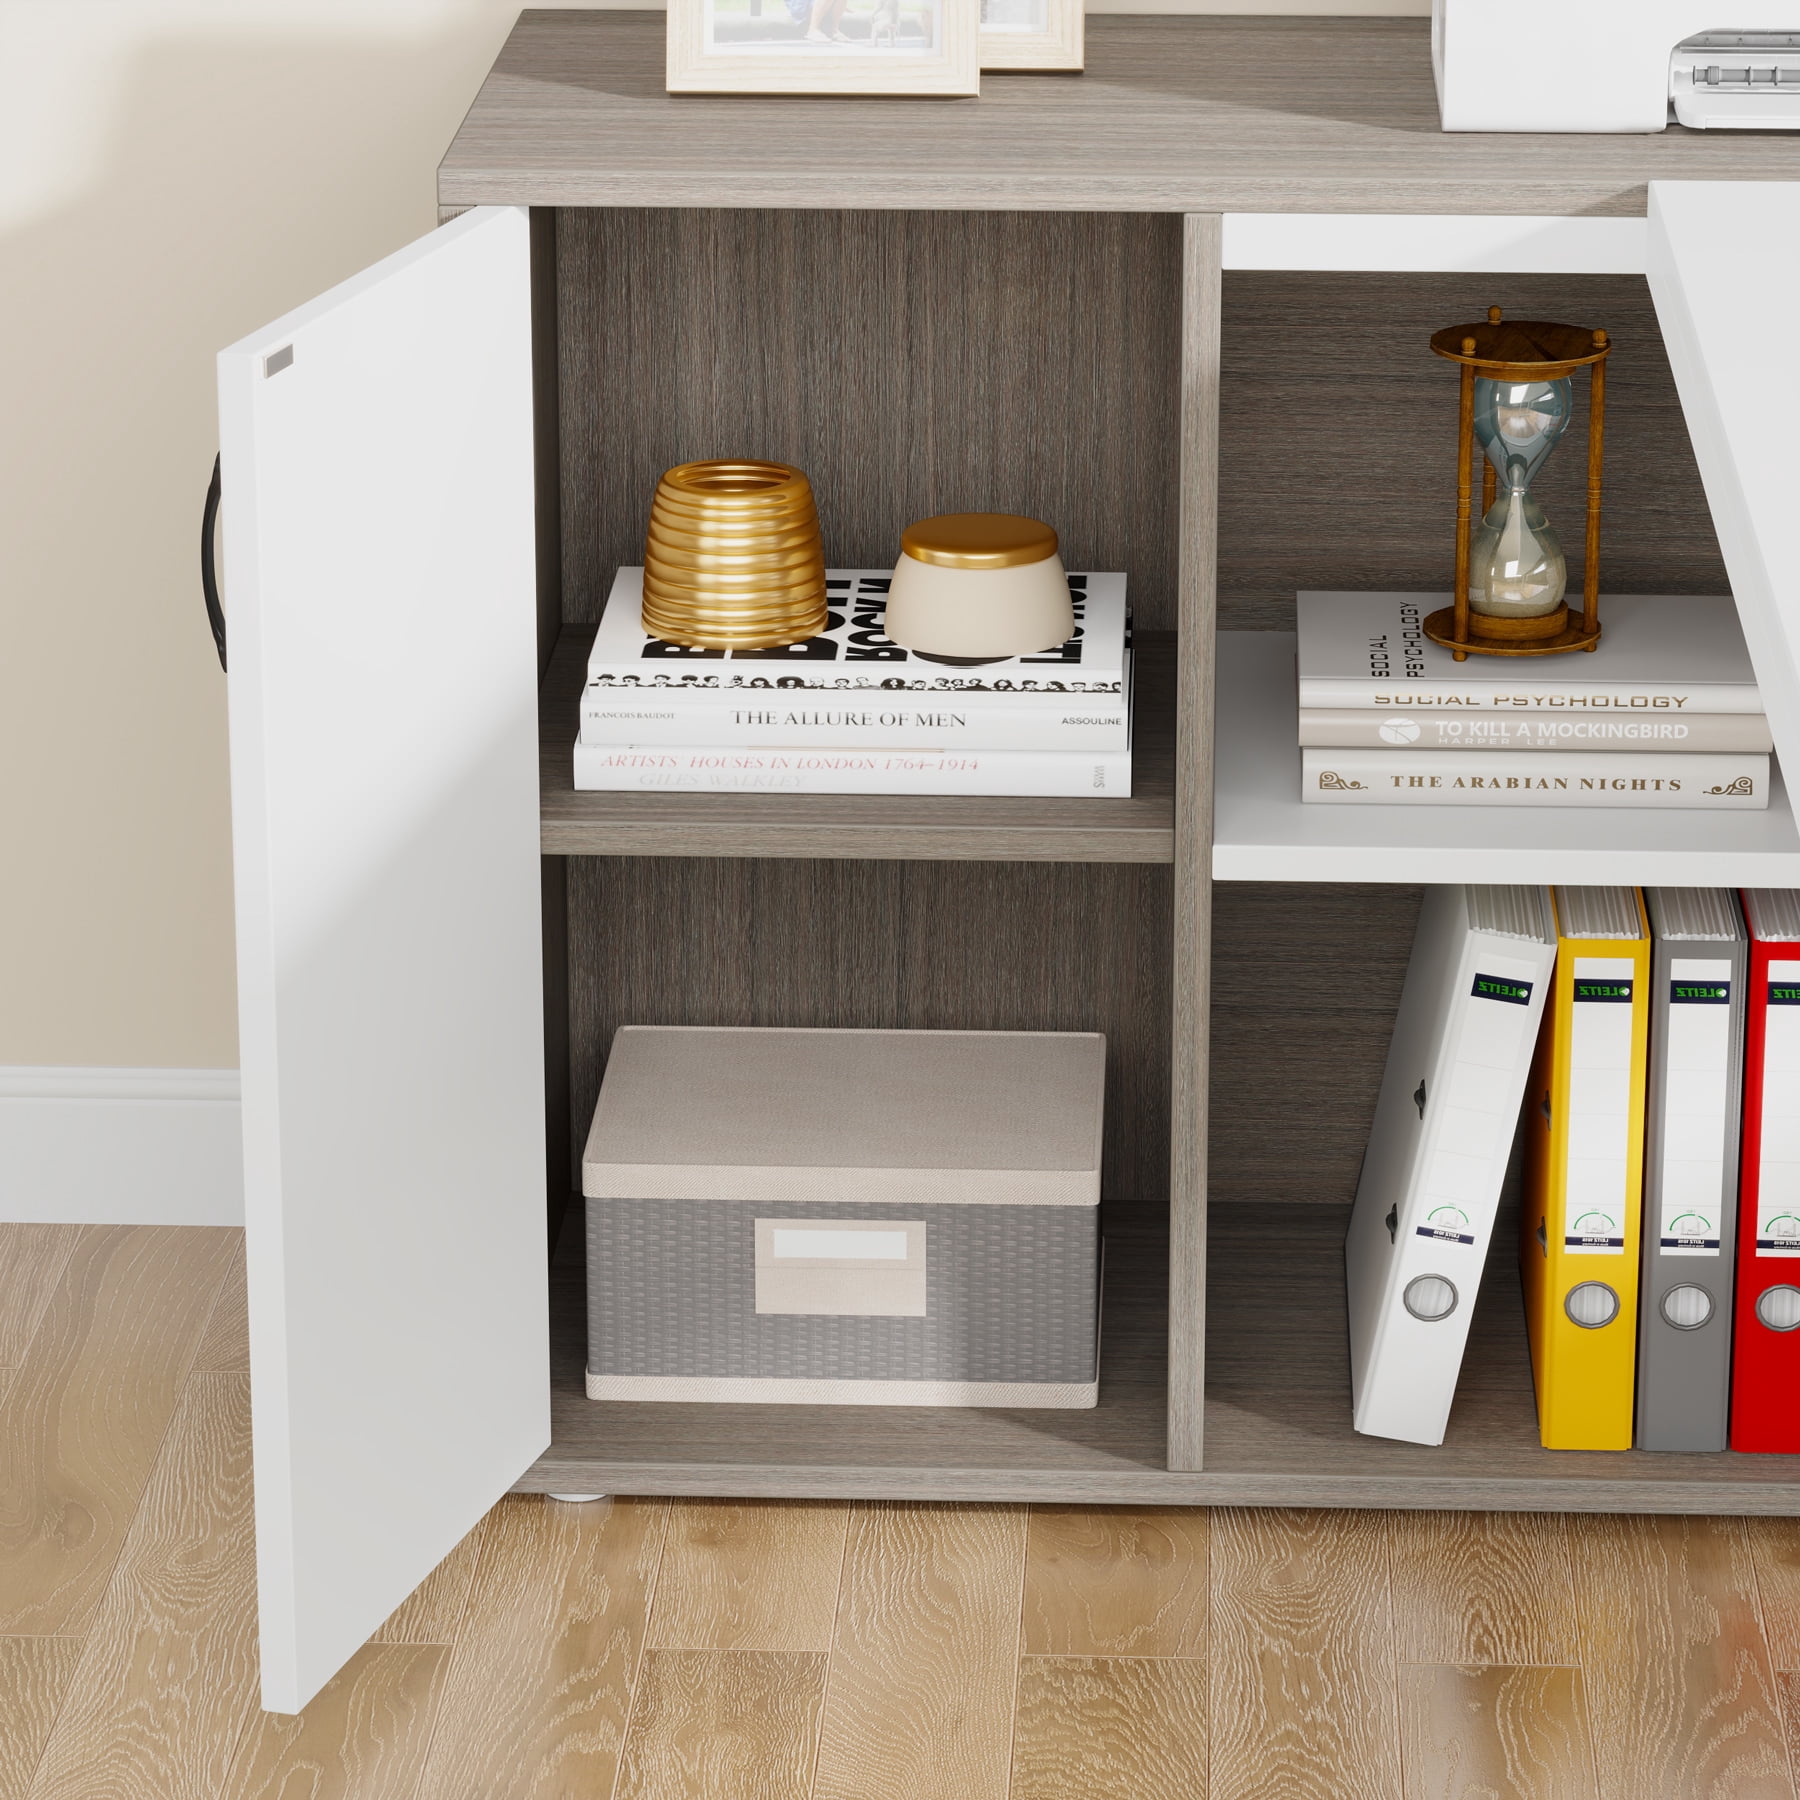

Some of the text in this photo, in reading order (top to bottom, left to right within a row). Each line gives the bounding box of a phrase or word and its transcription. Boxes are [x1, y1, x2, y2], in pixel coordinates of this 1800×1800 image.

[1399, 601, 1424, 678] PSYCHOLOGY
[1369, 634, 1390, 678] SOCIAL
[1374, 694, 1688, 708] SOCIAL PSYCHOLOGY
[637, 712, 676, 720] BAUDOT
[731, 710, 967, 728] THE ALLURE OF MEN
[1061, 717, 1122, 726] ASSOULINE
[1435, 721, 1689, 739] TO KILL A MOCKINGBIRD
[689, 756, 764, 769] HOUSES
[769, 757, 790, 769] IN
[795, 757, 877, 770] LONDON
[639, 774, 806, 788] GILES WALKLEY
[1391, 776, 1681, 791] THE ARABIAN NIGHTS
